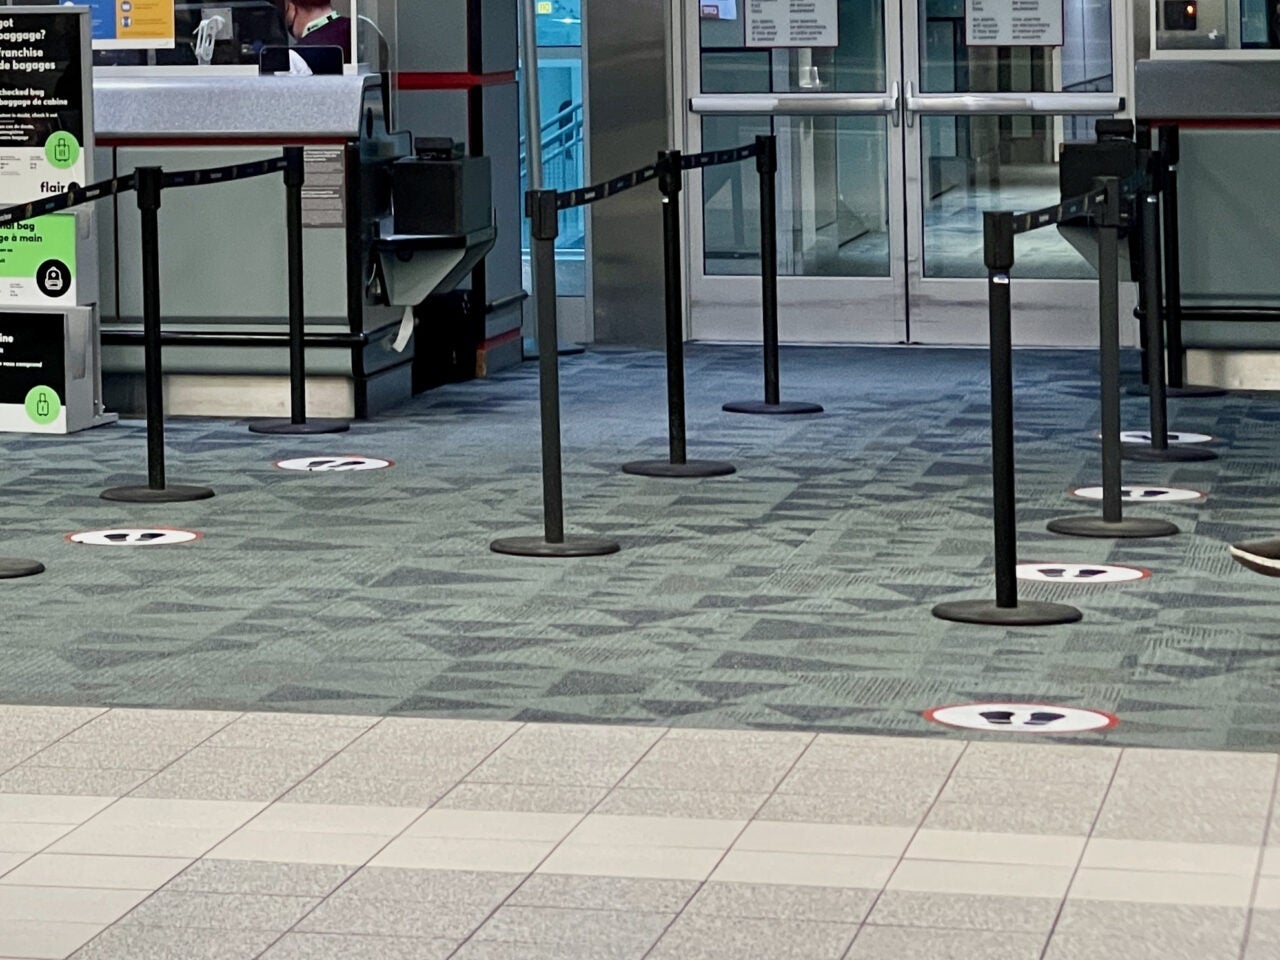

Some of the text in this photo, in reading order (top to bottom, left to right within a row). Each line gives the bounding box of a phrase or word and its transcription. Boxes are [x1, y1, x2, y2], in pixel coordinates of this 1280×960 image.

[12, 60, 56, 72] bagages
[30, 88, 45, 97] bag
[43, 97, 68, 106] cabine
[40, 181, 66, 193] flair
[16, 222, 35, 232] bag
[11, 233, 18, 242] à
[20, 233, 43, 243] main
